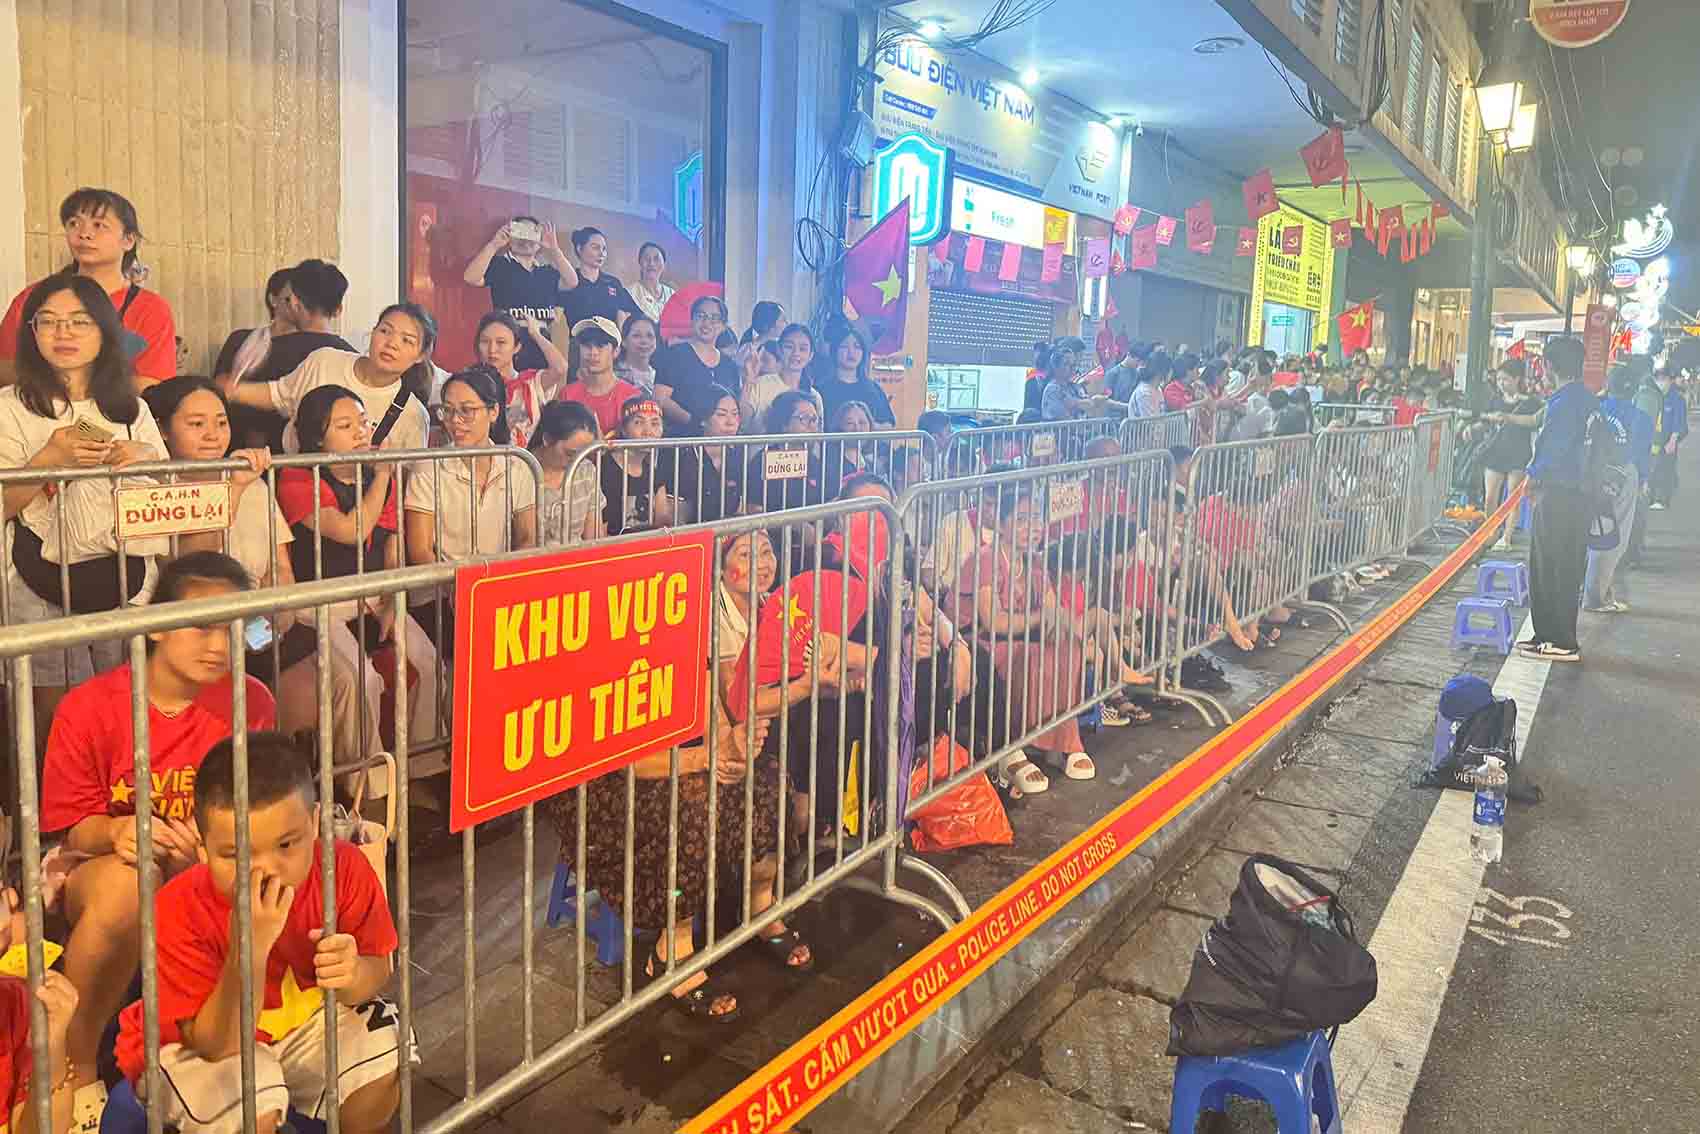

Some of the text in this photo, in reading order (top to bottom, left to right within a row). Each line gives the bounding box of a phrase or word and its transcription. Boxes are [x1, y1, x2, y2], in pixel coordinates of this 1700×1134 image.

[928, 58, 965, 96] ĐIỆN
[968, 76, 1002, 111] VIỆT
[1003, 93, 1035, 128] NAM
[125, 502, 224, 525] DỪNG LẠI
[150, 488, 201, 502] C.A.H.N
[493, 571, 688, 671] KHU VỰC
[503, 657, 674, 772] ƯU TIÊN
[803, 1036, 852, 1090] CẤM
[852, 988, 910, 1049] VƯỢT
[912, 960, 950, 1001] QUA
[957, 913, 1010, 969] POLICE
[1010, 889, 1043, 928] LINE.
[1040, 874, 1060, 902] DO
[1060, 855, 1084, 883] NOT
[1082, 831, 1118, 871] CROSS
